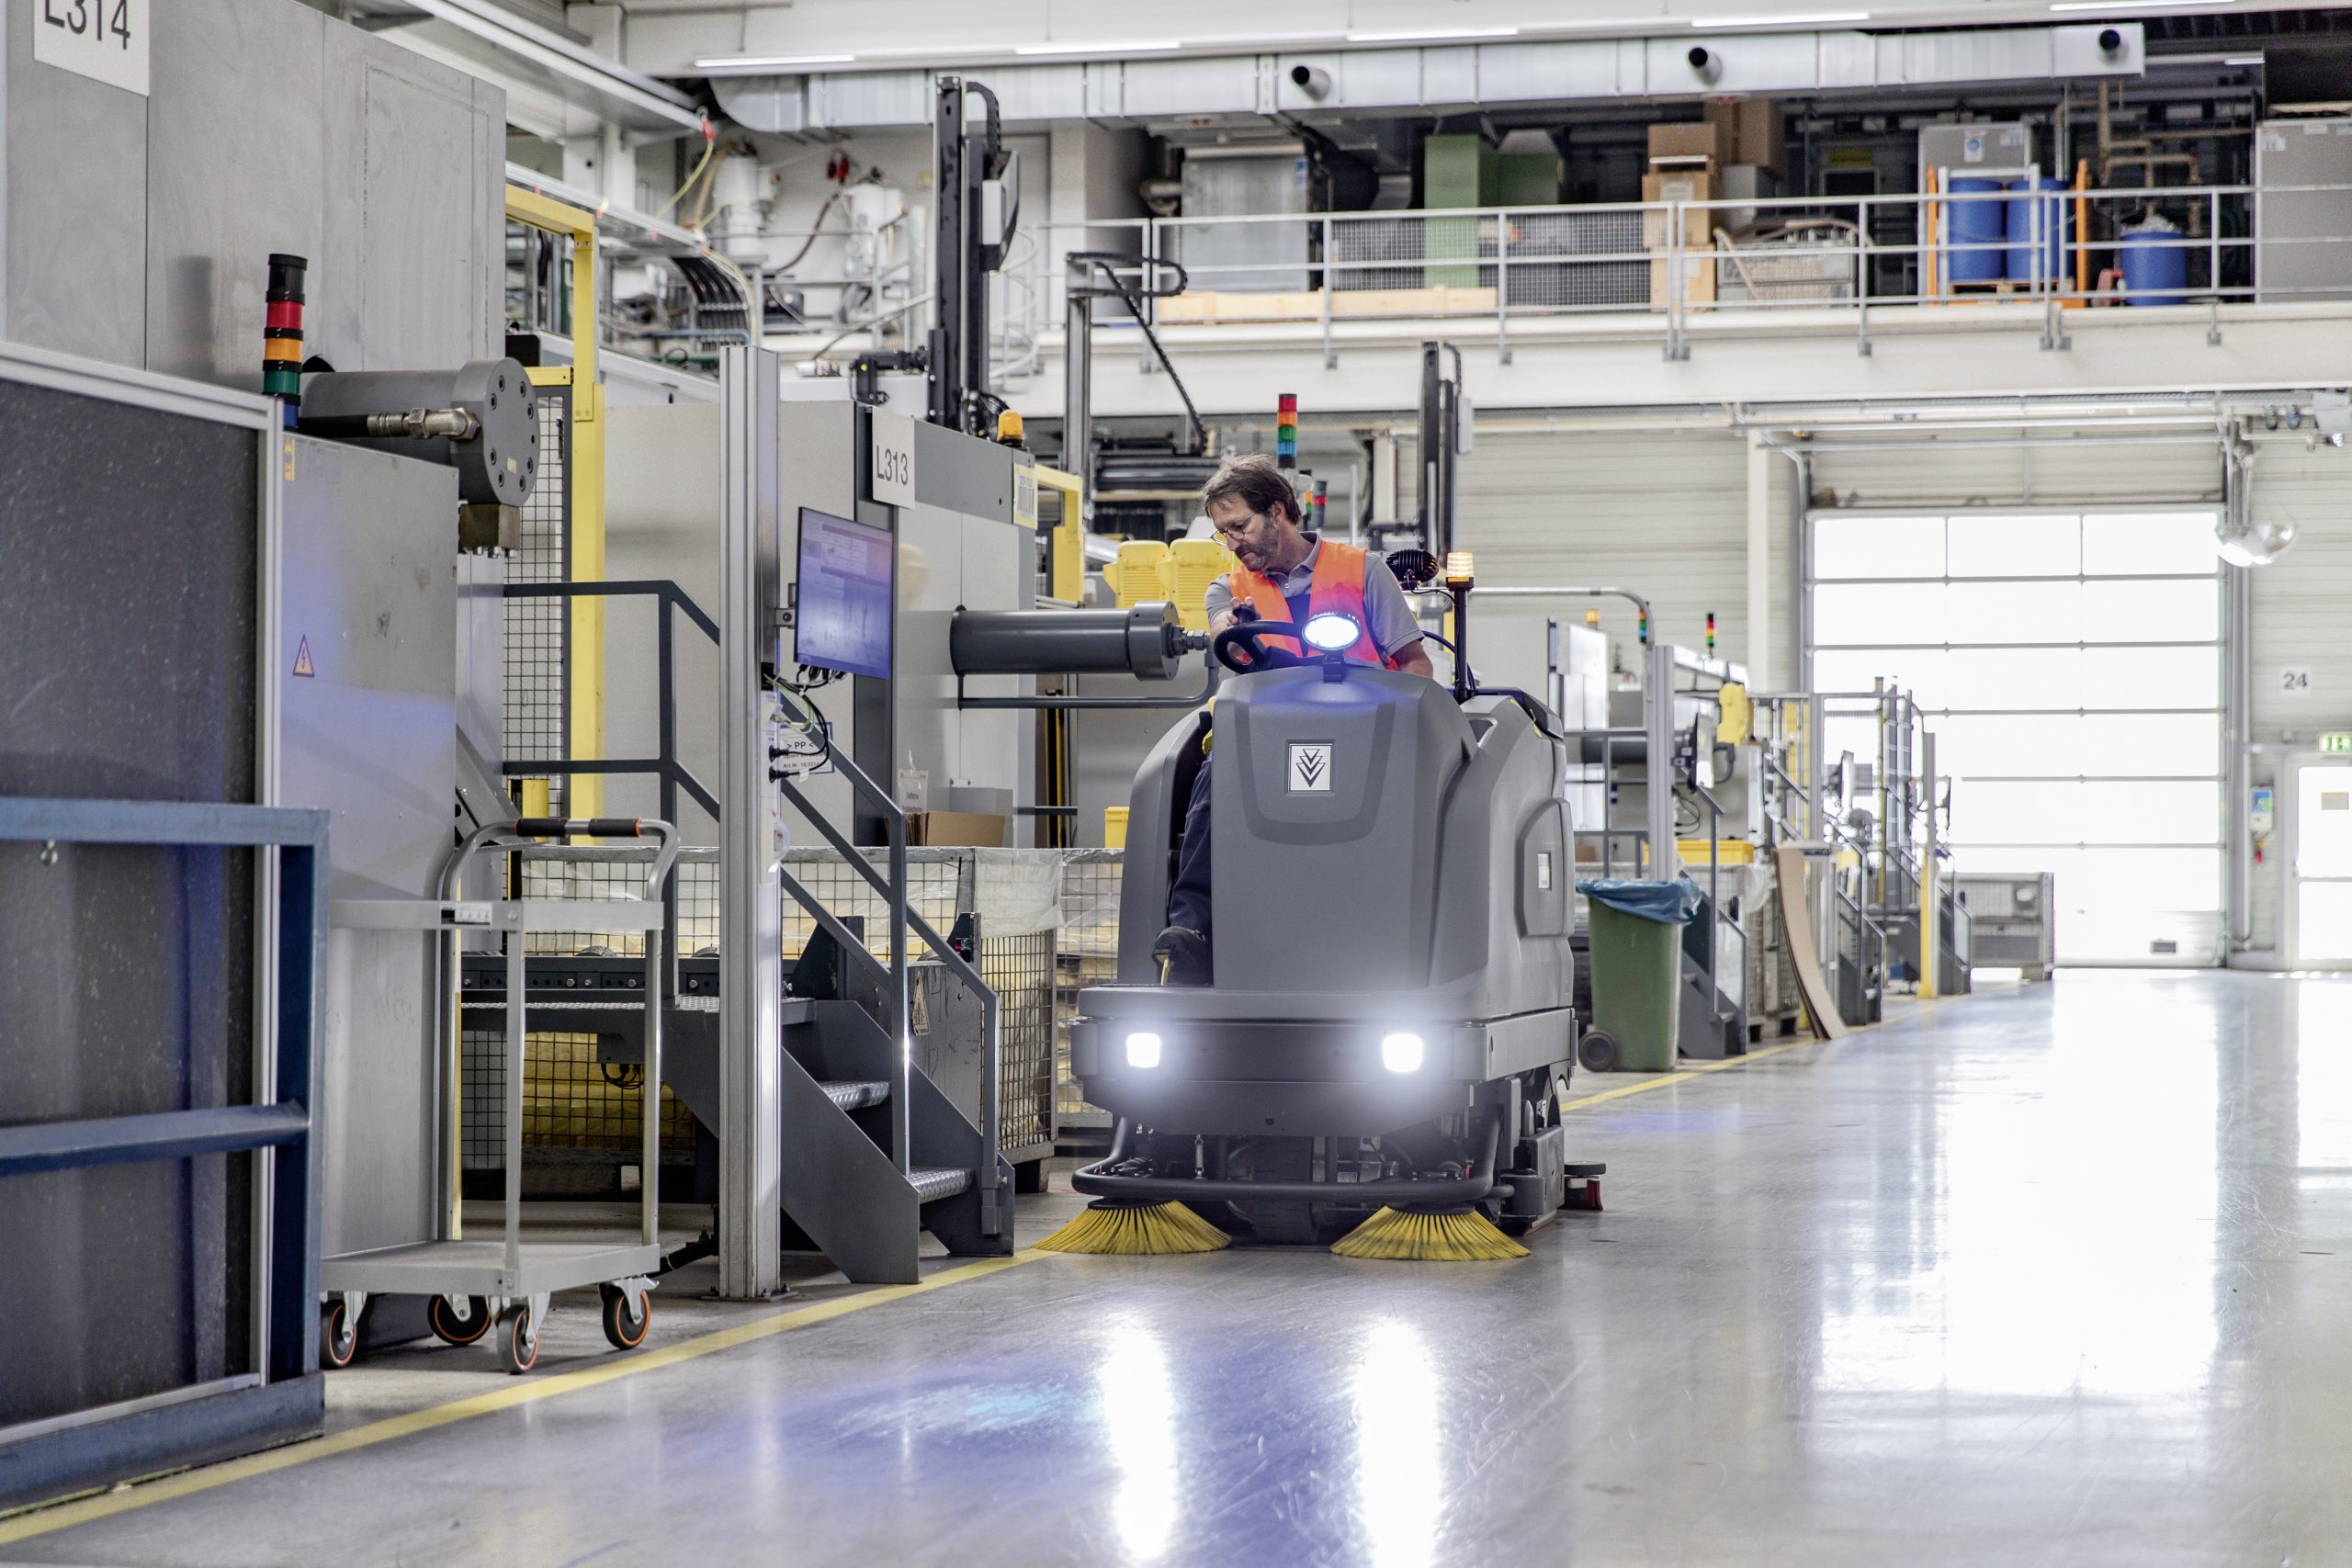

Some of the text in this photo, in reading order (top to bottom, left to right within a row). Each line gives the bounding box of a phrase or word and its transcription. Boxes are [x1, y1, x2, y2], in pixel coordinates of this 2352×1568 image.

[876, 445, 908, 486] L313
[2282, 672, 2308, 690] 24
[794, 741, 807, 750] PP
